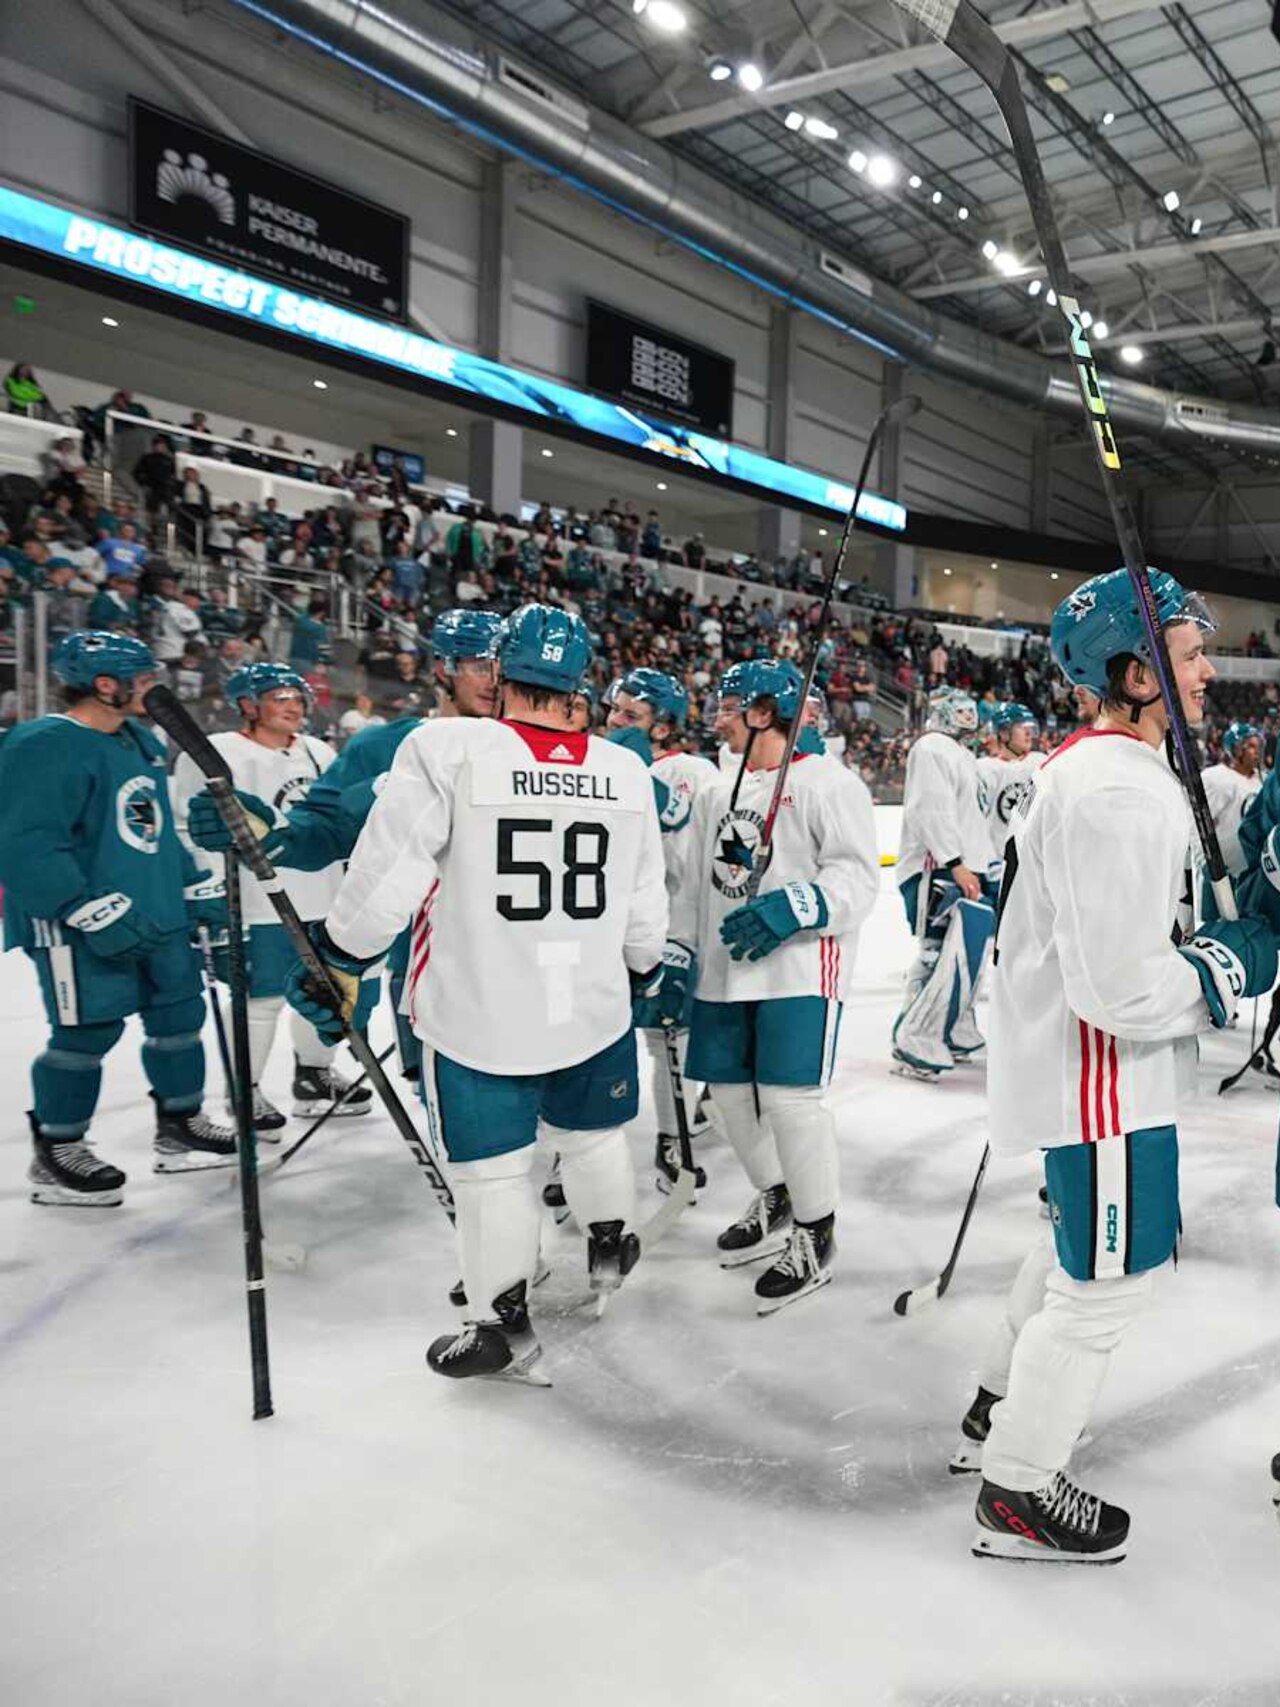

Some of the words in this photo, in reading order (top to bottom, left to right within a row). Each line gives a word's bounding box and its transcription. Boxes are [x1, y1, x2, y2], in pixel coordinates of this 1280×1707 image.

[248, 193, 319, 237] KAISER
[63, 215, 273, 315] PROSPECT
[248, 215, 387, 284] PERMANENTE
[540, 644, 562, 663] 58
[512, 769, 619, 801] RUSSELL
[495, 817, 611, 922] 58
[1106, 1203, 1118, 1253] CCM
